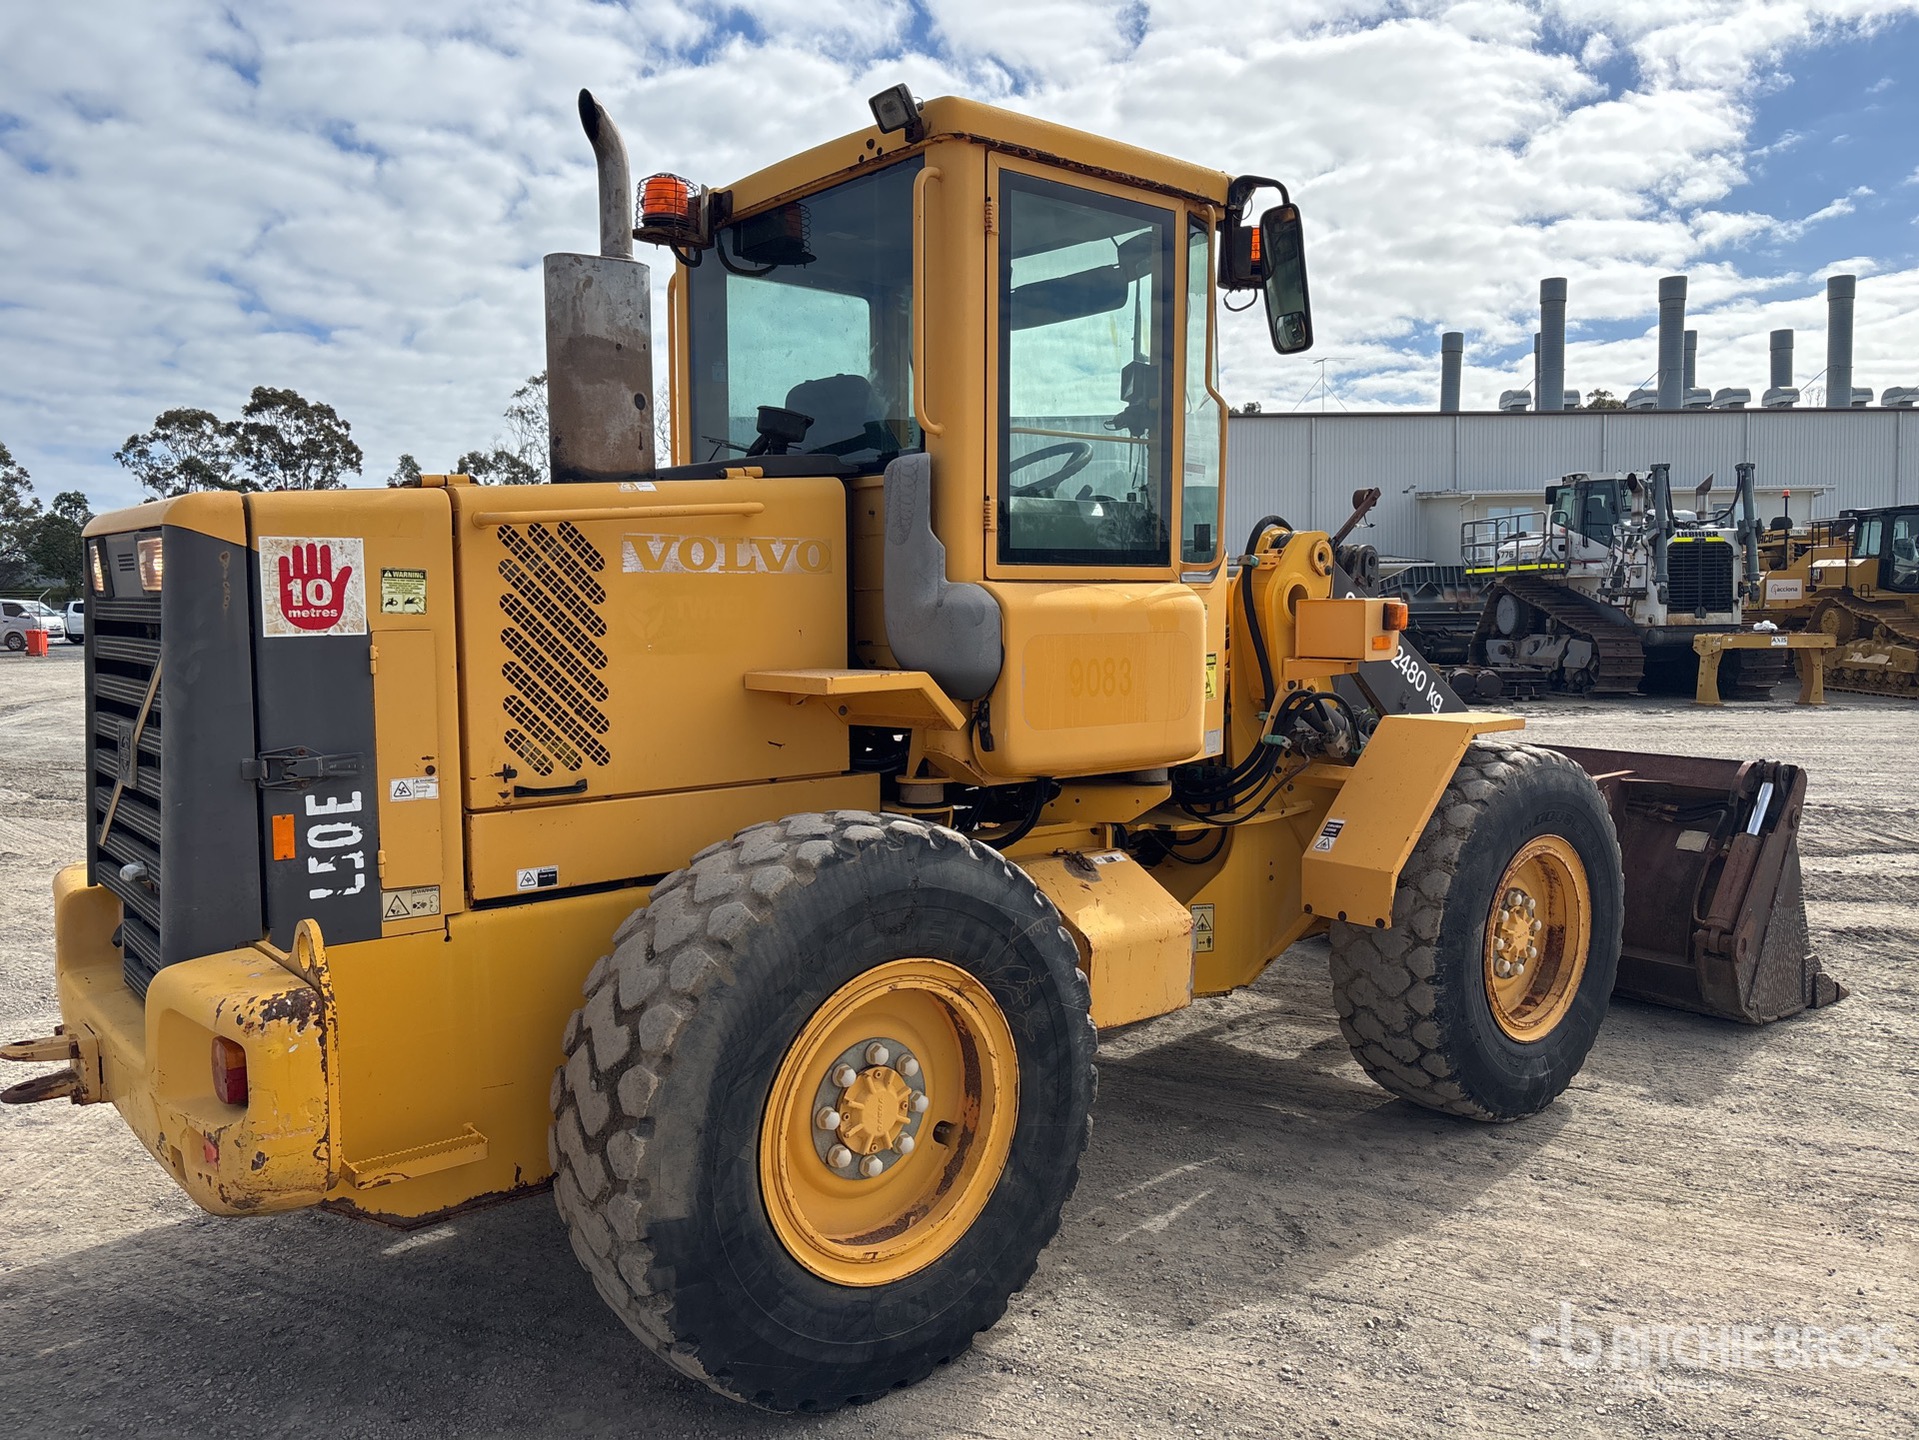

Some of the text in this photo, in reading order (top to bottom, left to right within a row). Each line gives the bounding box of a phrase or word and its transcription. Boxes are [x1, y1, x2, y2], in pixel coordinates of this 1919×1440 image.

[623, 535, 831, 573] VOLVO
[1500, 550, 1514, 558] 776
[287, 578, 333, 607] 10
[288, 608, 338, 618] metres
[1069, 656, 1132, 697] 9083
[1390, 645, 1444, 714] 2480 kg
